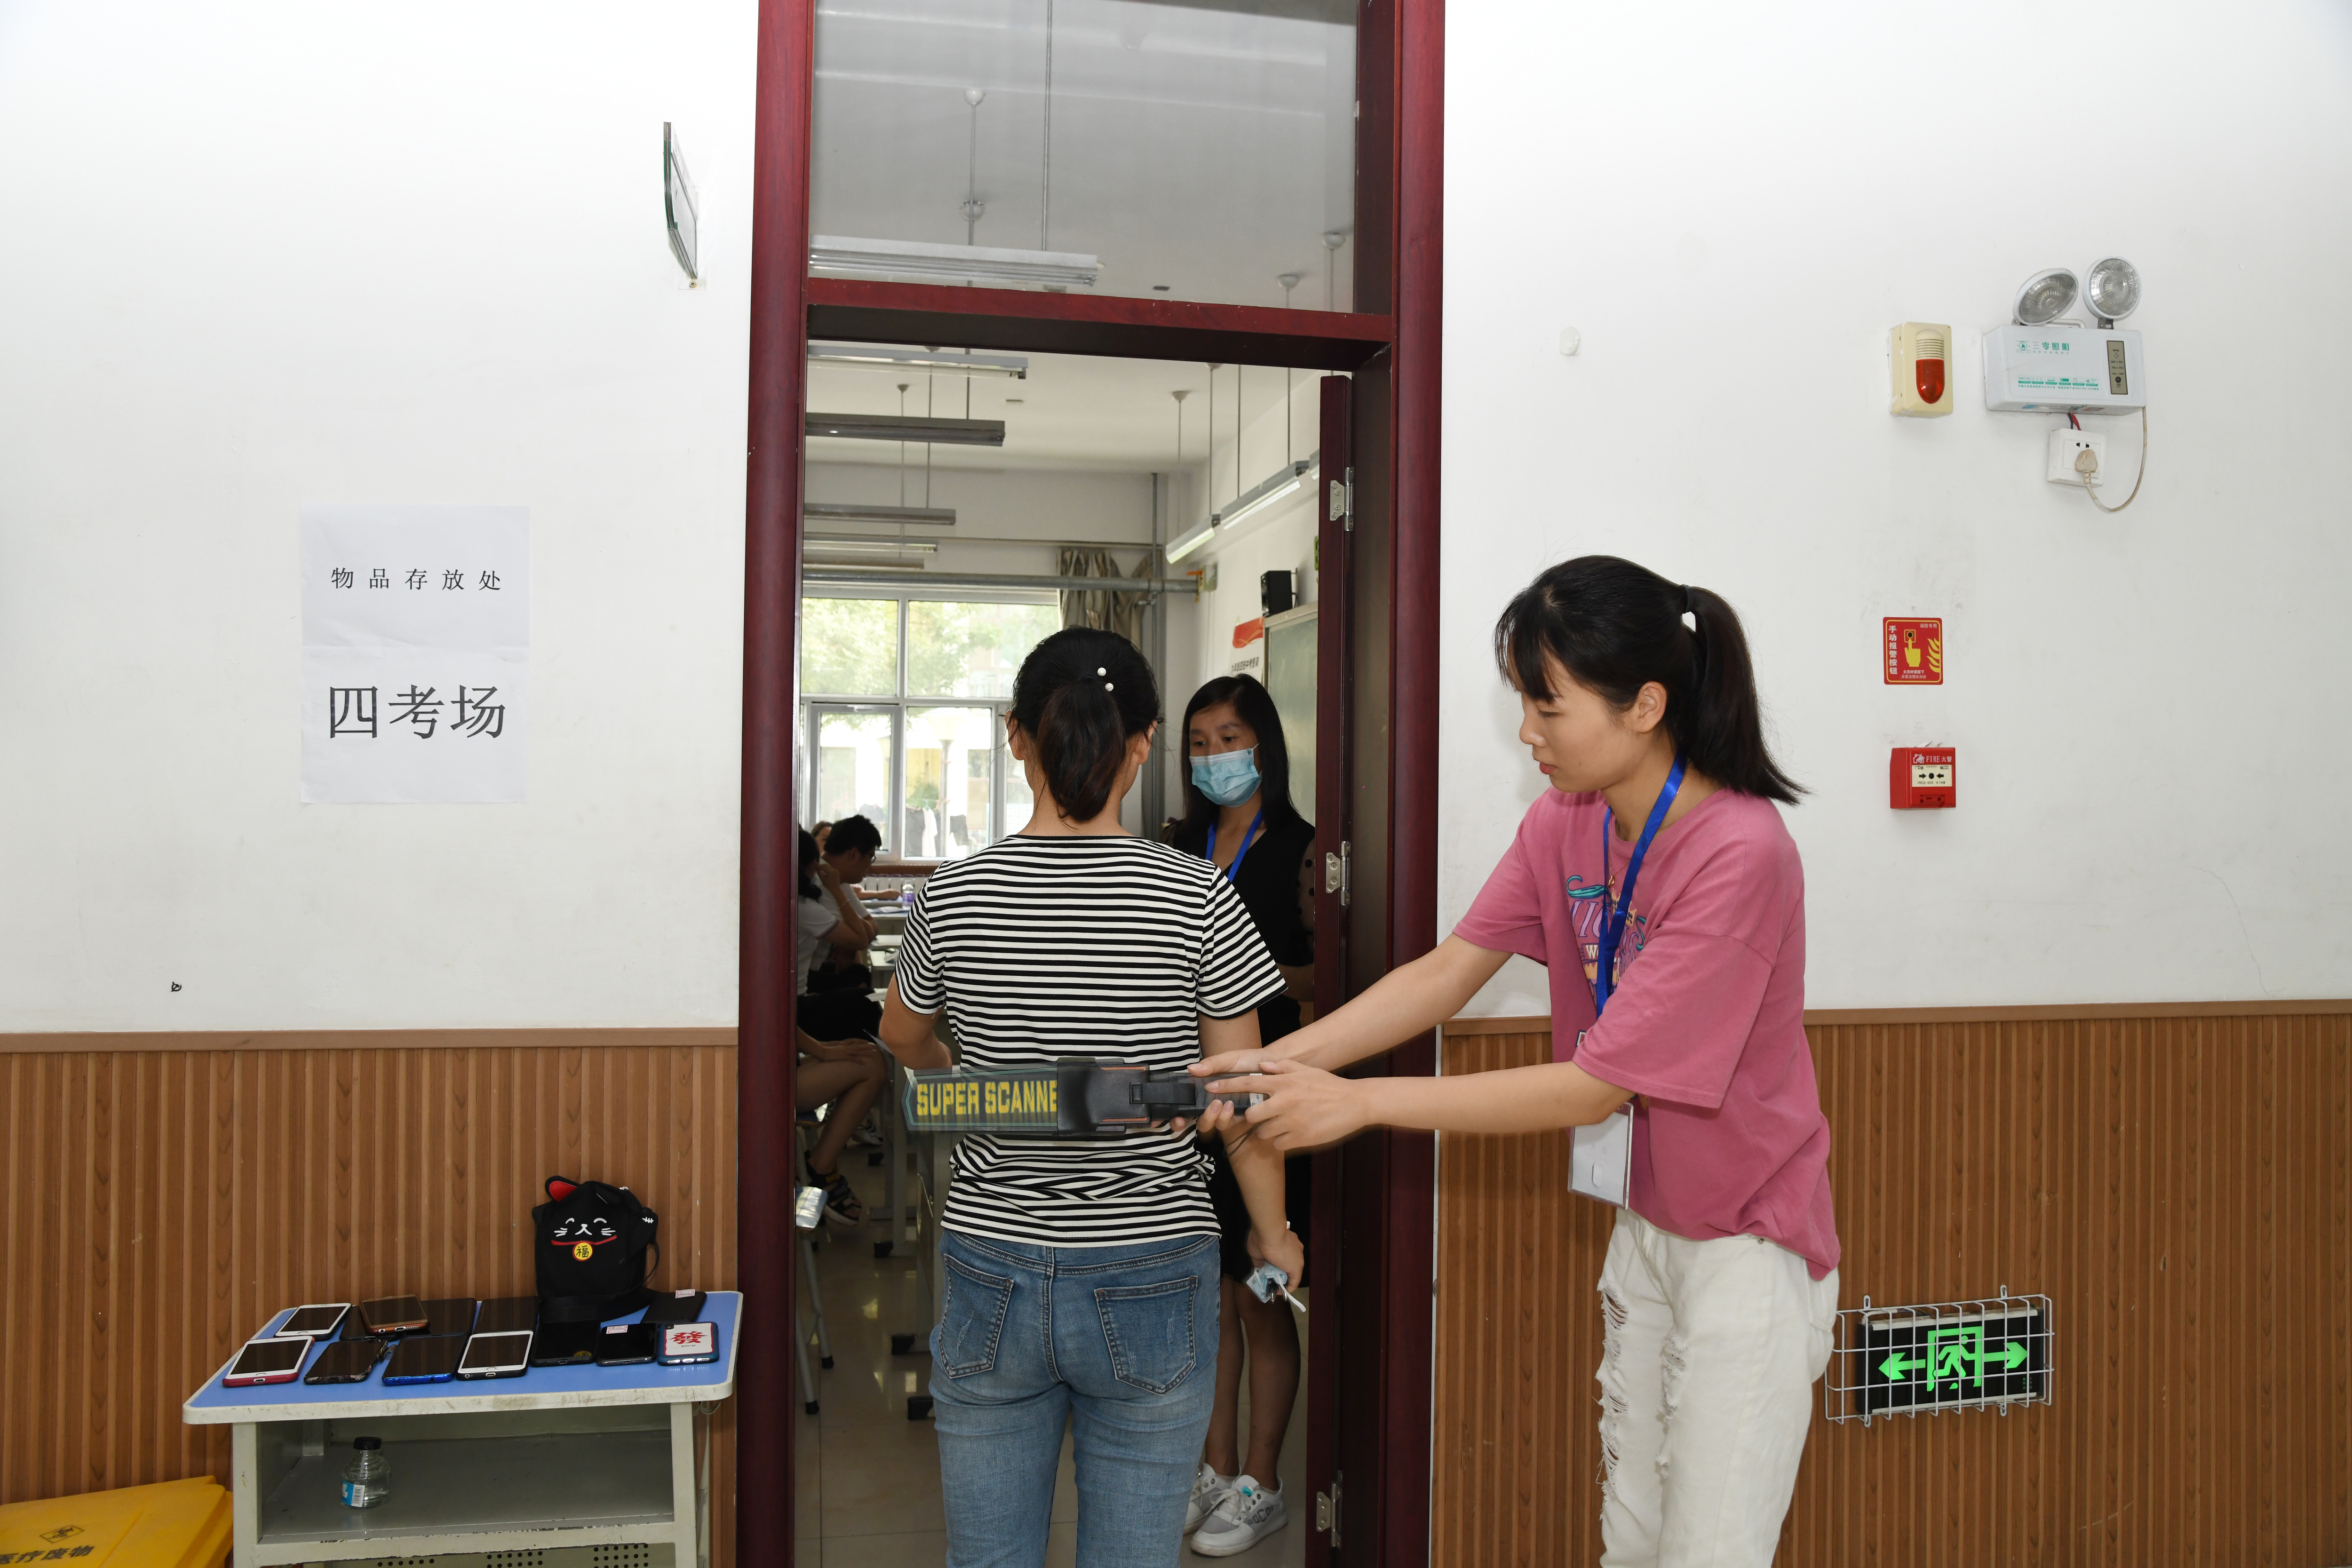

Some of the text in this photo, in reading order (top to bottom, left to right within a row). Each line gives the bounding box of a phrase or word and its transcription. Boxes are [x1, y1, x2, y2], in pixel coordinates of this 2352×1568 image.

[331, 567, 501, 591] 物品存放处
[1888, 625, 1898, 675] 手动报警按钮
[330, 684, 506, 739] 四考场
[917, 1082, 980, 1115] SUPER
[576, 1245, 589, 1258] 福
[669, 1331, 708, 1345] 發
